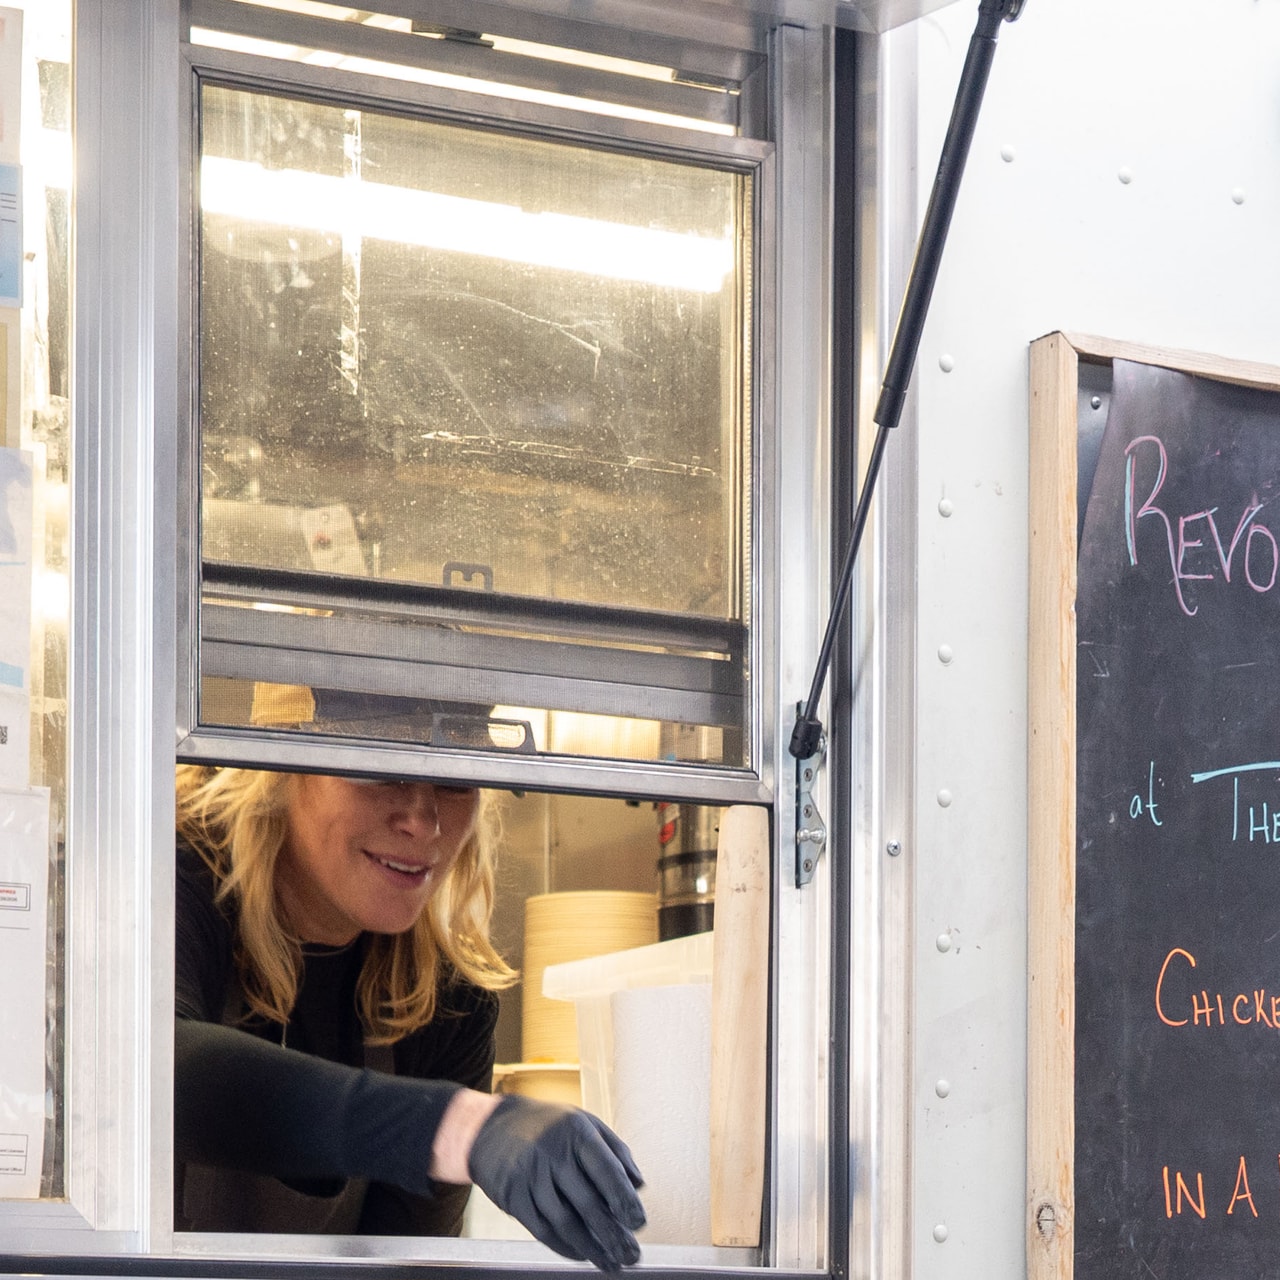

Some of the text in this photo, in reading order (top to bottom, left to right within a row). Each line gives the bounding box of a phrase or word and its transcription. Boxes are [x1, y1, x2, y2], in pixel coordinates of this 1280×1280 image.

[1129, 761, 1163, 827] at
[1162, 1165, 1206, 1220] IN
[1226, 1155, 1258, 1218] A
